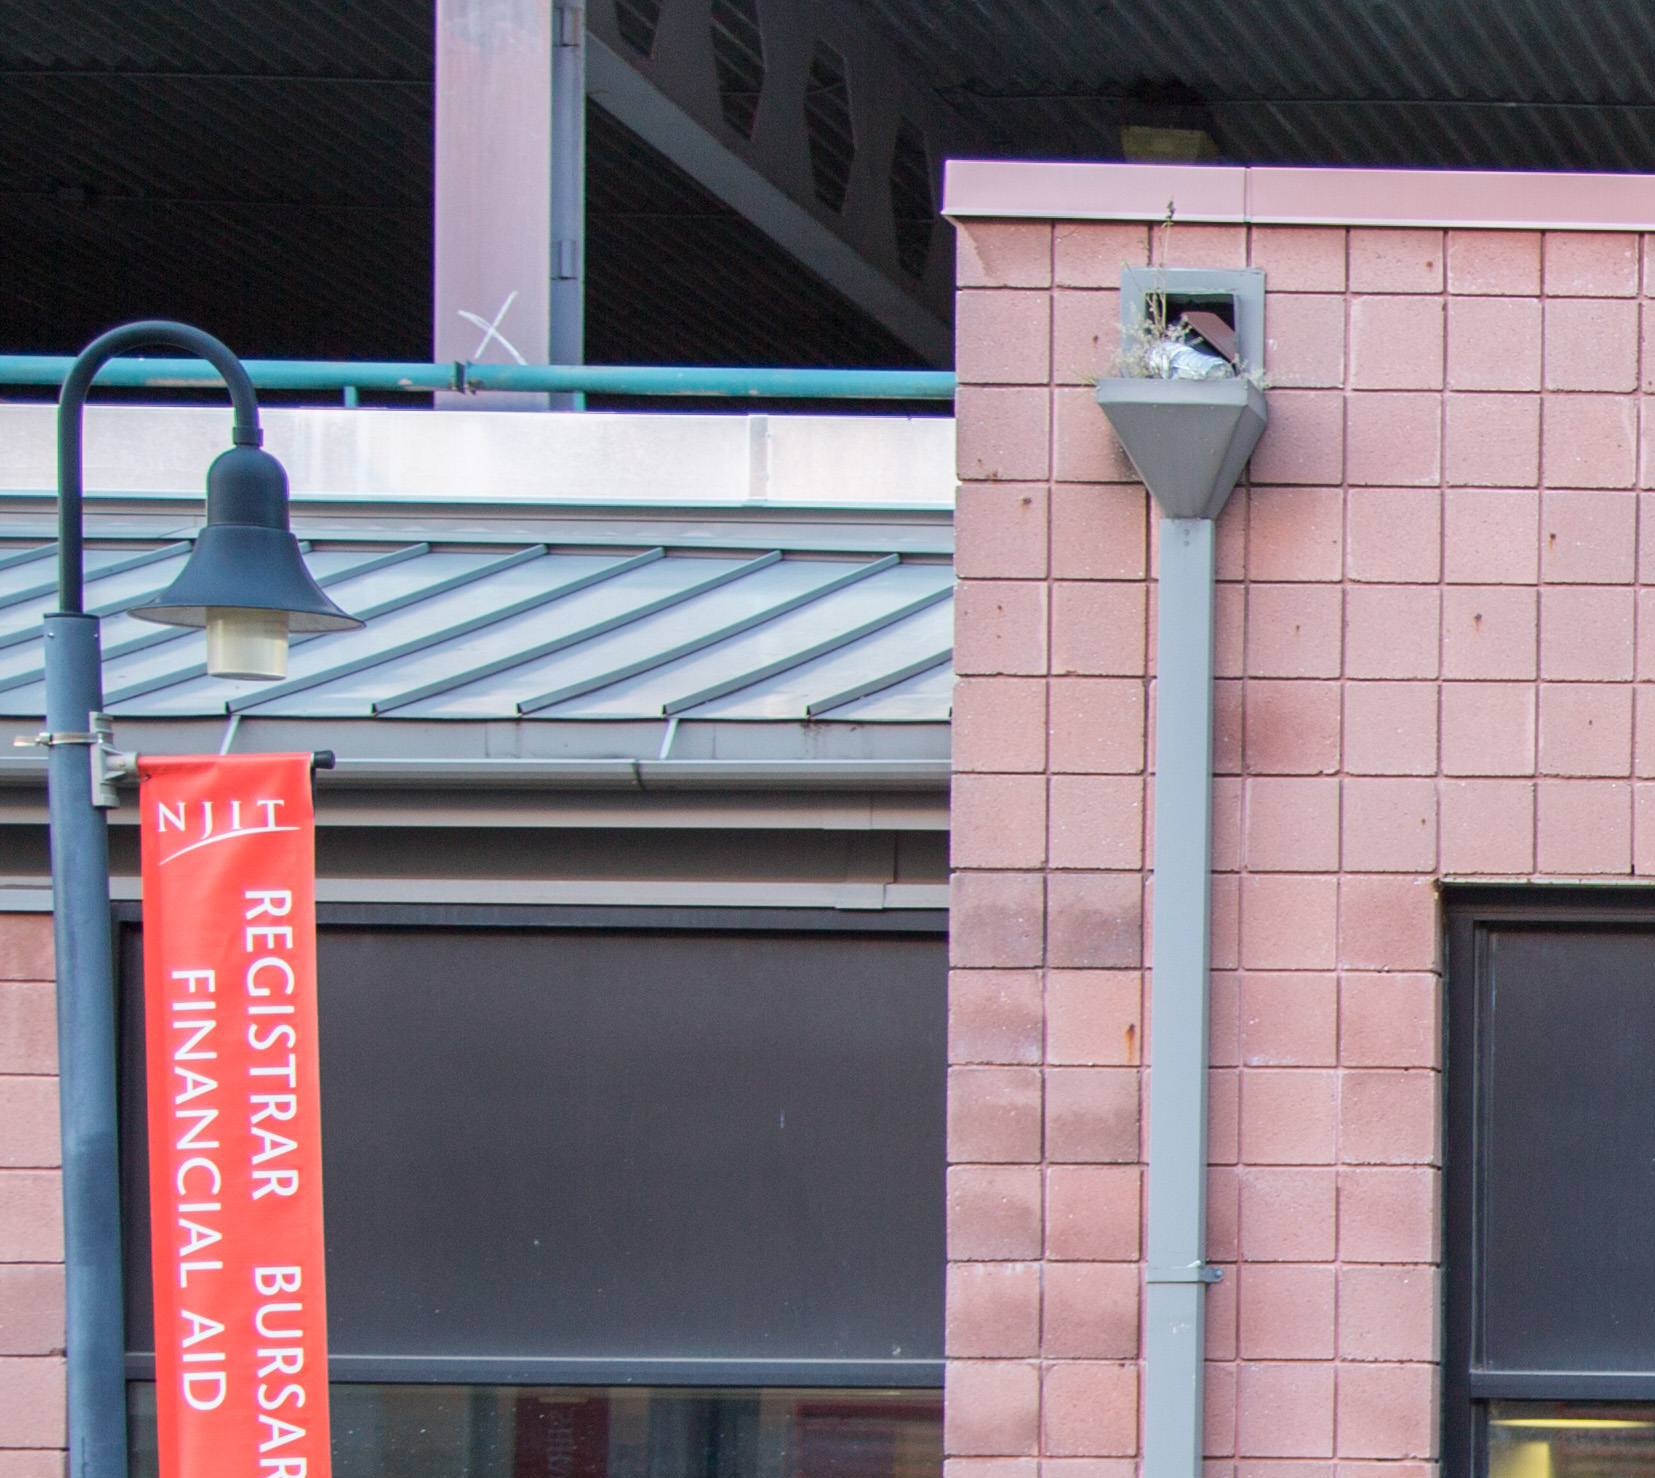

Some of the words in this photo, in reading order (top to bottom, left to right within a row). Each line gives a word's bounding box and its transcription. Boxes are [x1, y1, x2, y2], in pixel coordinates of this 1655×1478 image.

[158, 799, 285, 840] NJIT
[172, 970, 222, 1288] FINANCIAL
[246, 890, 298, 1200] REGISTRAR
[182, 1310, 226, 1410] AID
